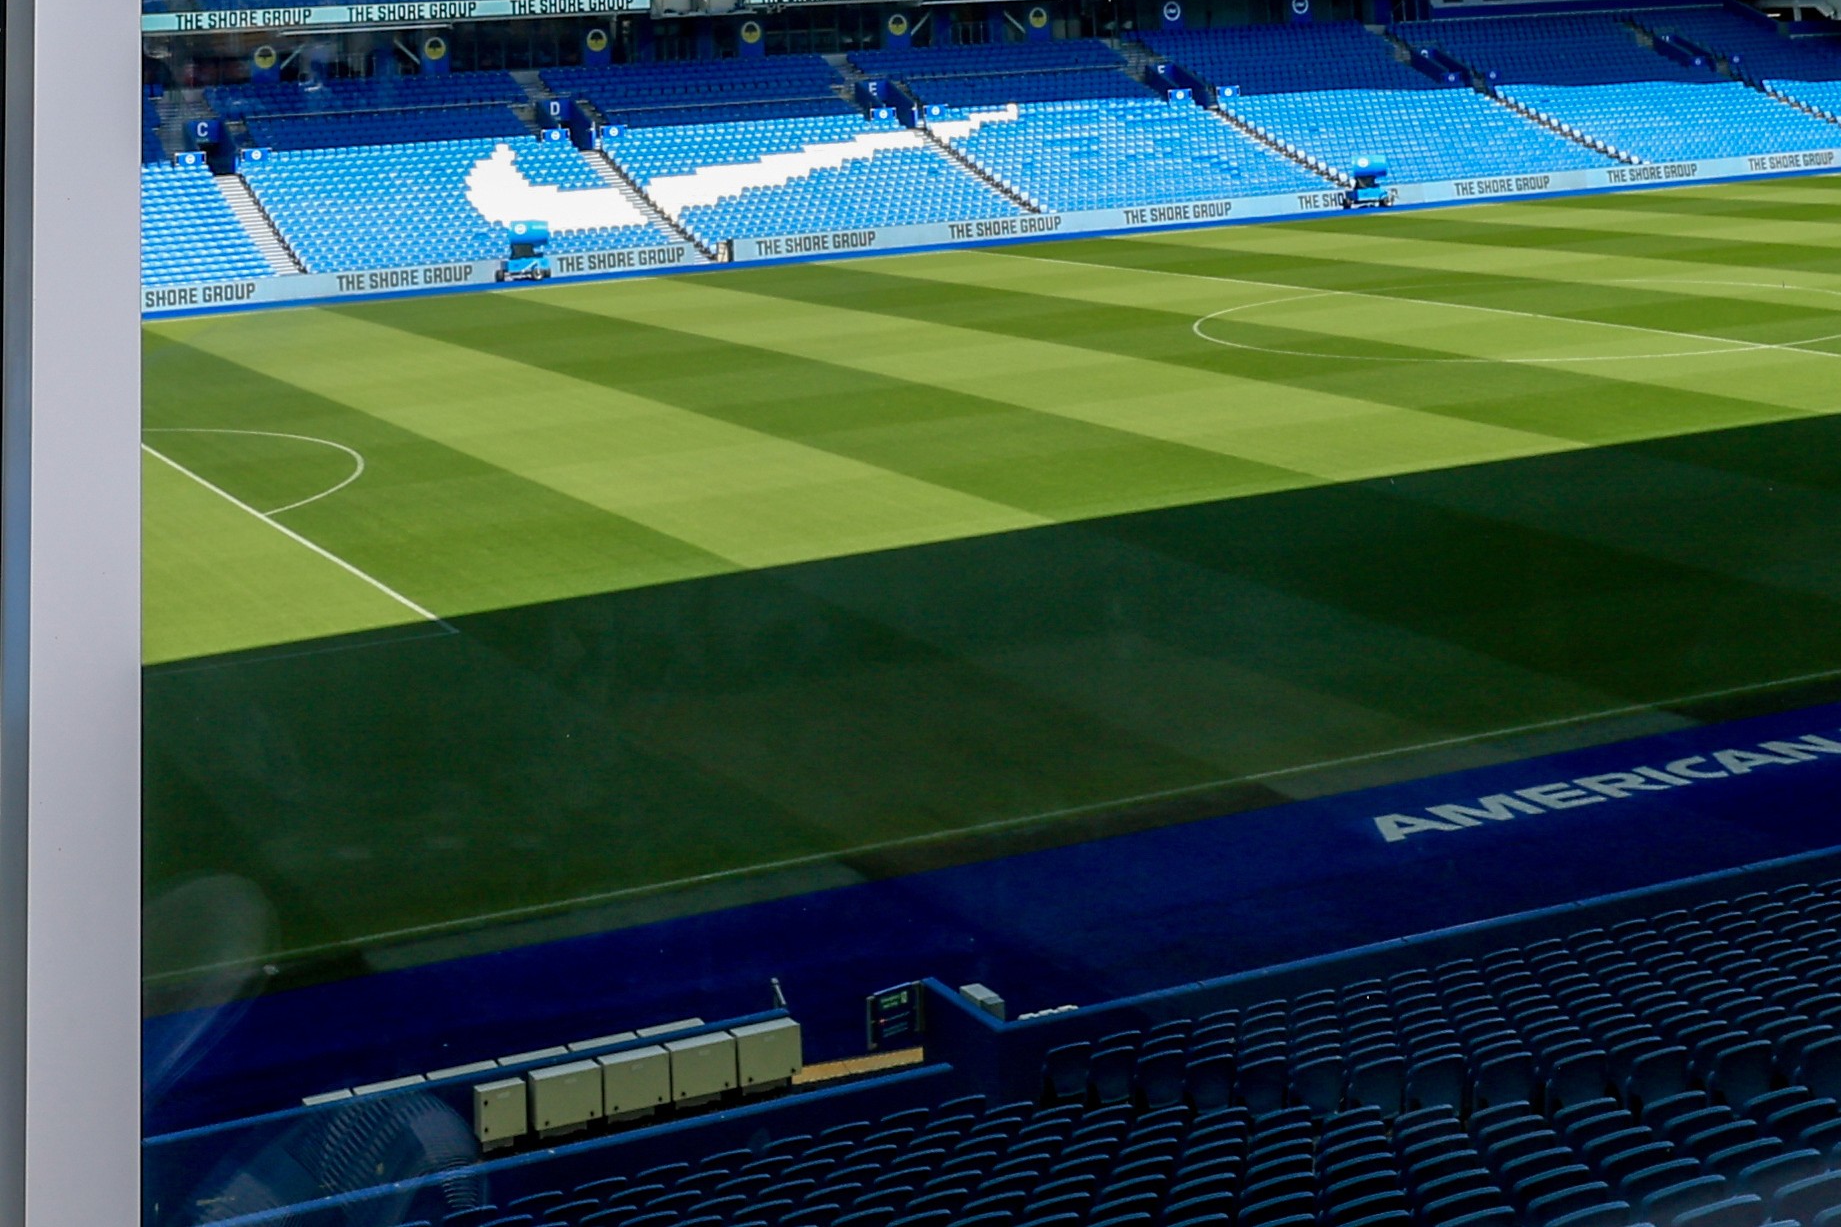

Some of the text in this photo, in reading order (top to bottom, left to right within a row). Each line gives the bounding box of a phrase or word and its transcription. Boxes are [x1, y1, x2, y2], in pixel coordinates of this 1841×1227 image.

[347, 1, 476, 23] THE SHORE GROUP
[510, 0, 535, 15] THE
[176, 9, 312, 30] THE SHORE GROUP
[550, 102, 560, 116] D
[197, 122, 208, 138] C
[1748, 151, 1834, 172] THE SHORE GROUP
[1607, 163, 1698, 184] THE SHORE GROUP
[1454, 175, 1550, 197] THE SHORE GROUP
[1298, 192, 1344, 210] THE SHO
[1124, 200, 1232, 225] THE SHORE GROUP
[949, 216, 1062, 240] THE SHORE GROUP
[756, 231, 876, 257] THE SHORE GROUP
[558, 247, 685, 273] THE SHORE GROUP
[337, 264, 472, 292] THE SHORE GROUP
[145, 282, 256, 308] SHORE GROUP
